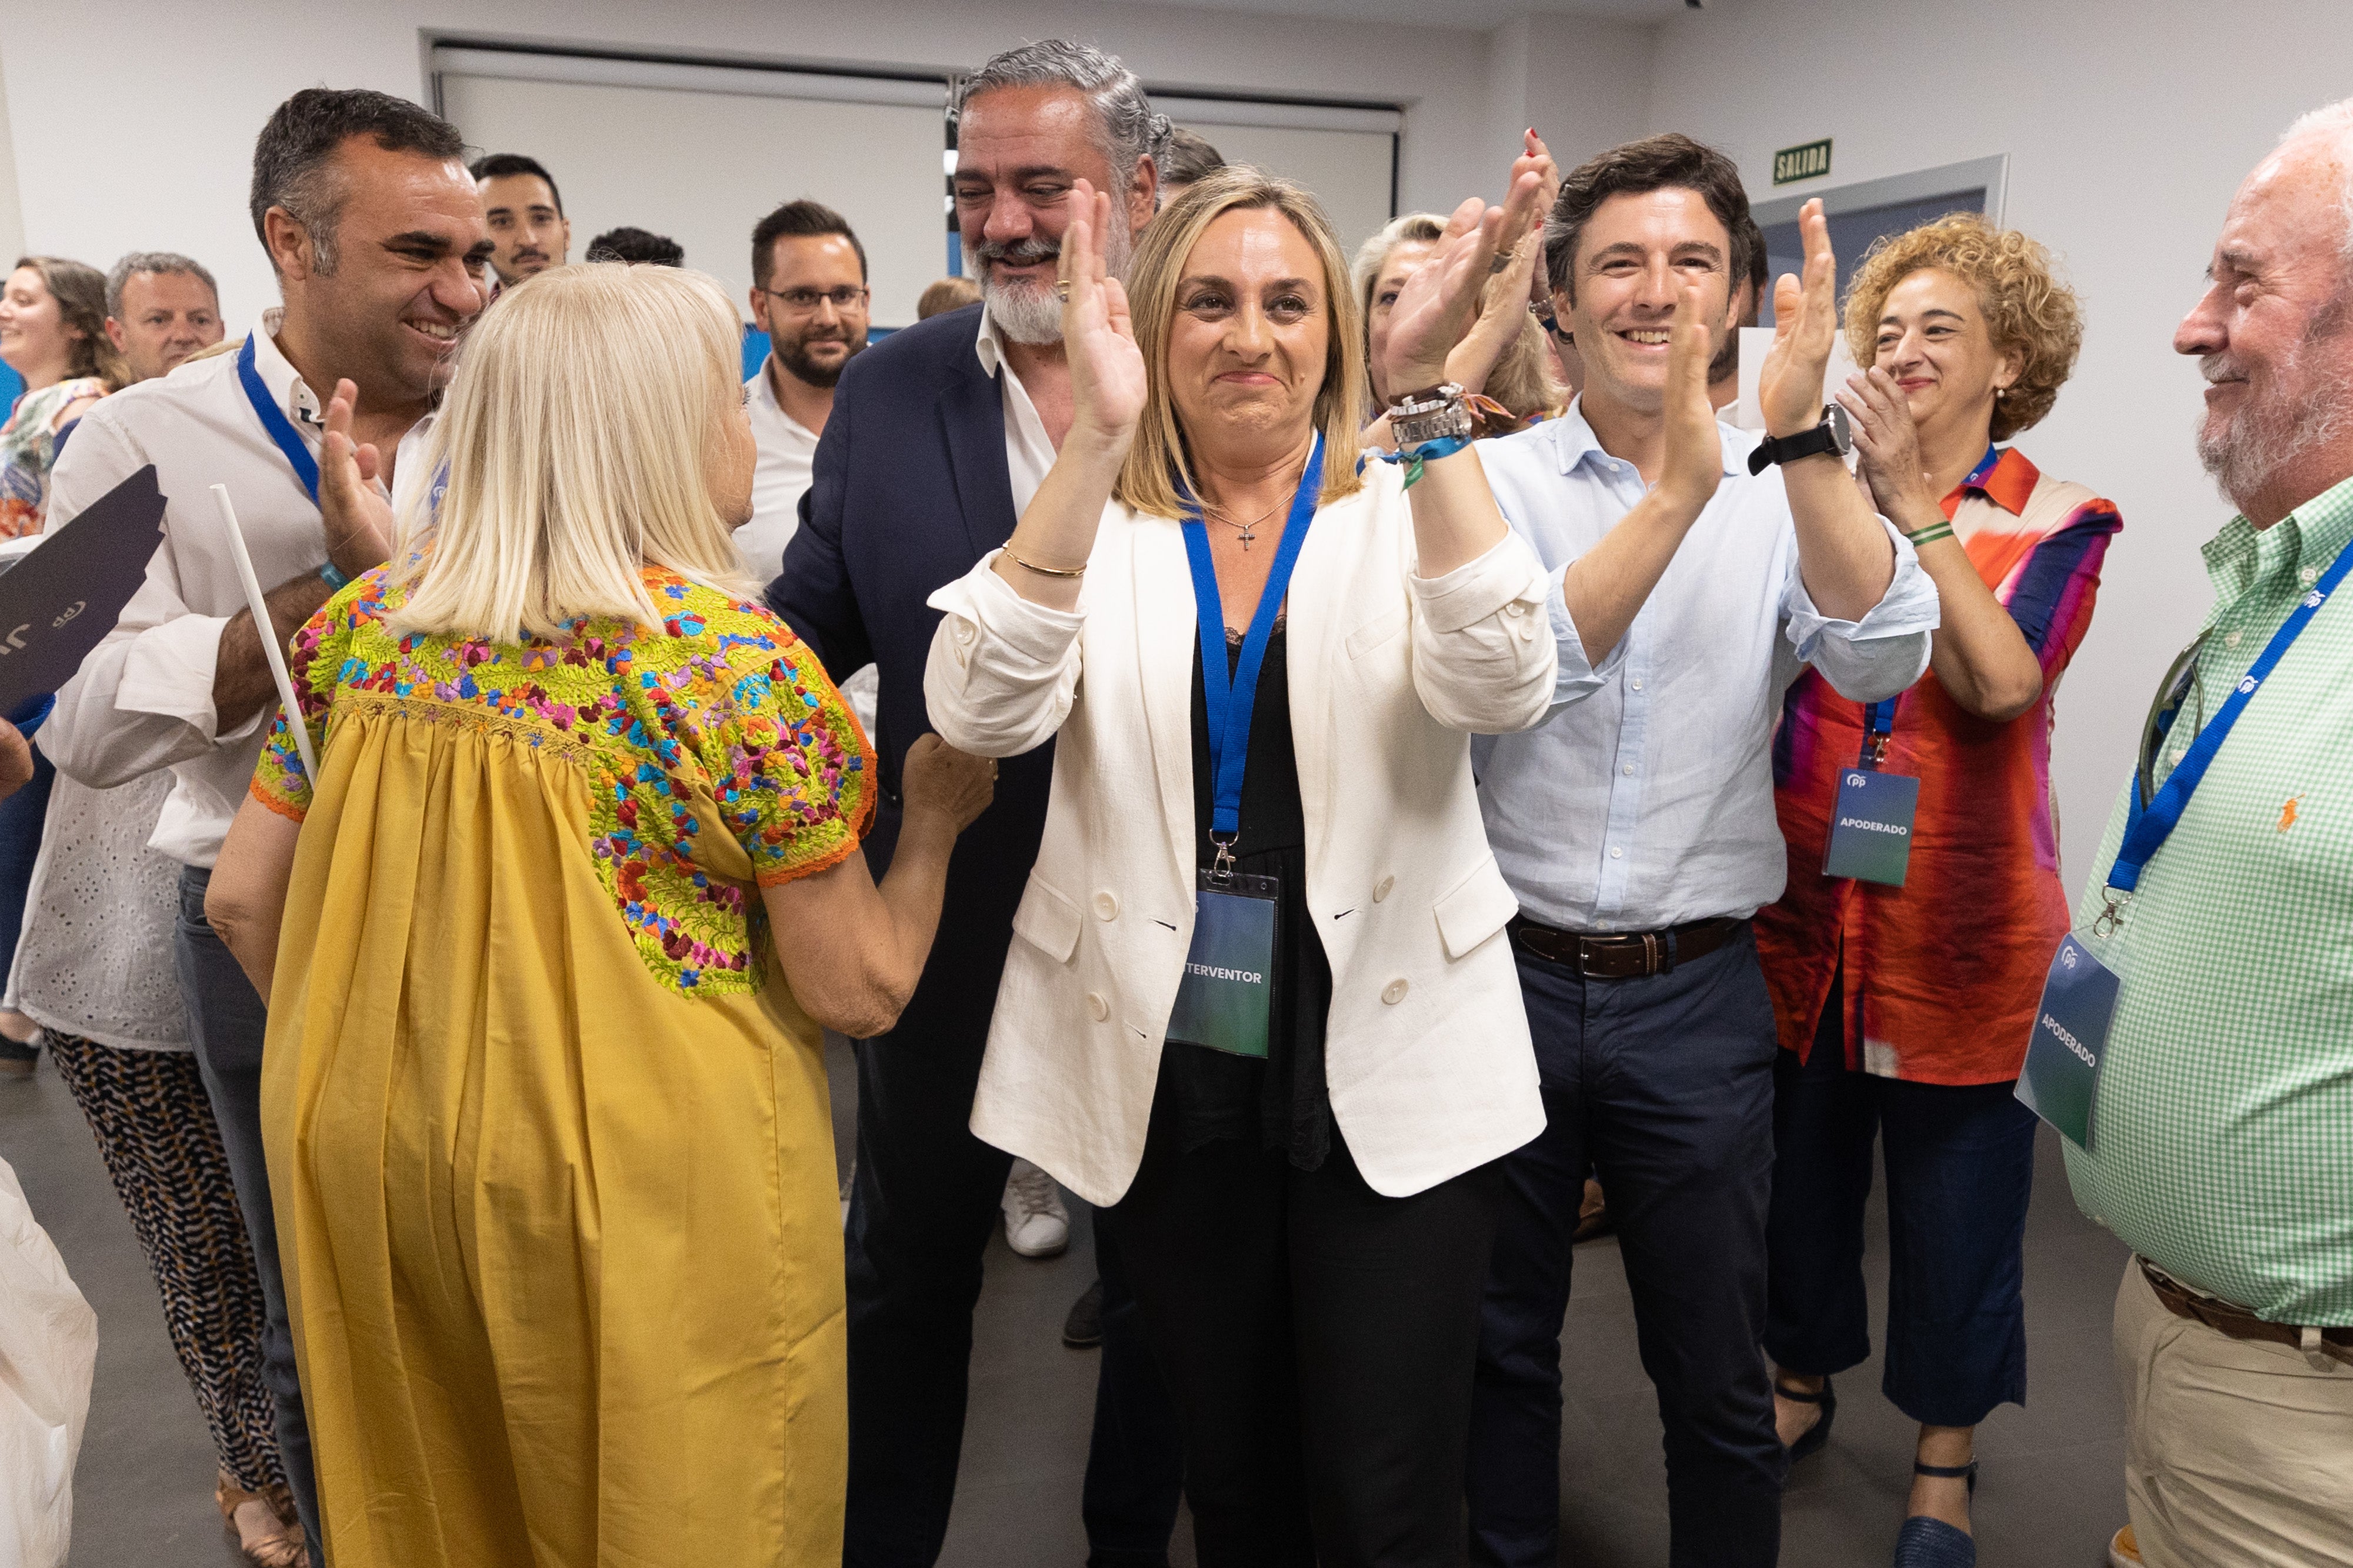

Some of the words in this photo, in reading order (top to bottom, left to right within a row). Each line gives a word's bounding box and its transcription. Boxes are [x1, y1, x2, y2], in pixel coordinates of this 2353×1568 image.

[1778, 145, 1827, 179] SALIDA
[1840, 818, 1907, 835] APODERADO
[1184, 962, 1262, 984] TERVENTOR
[2042, 1013, 2096, 1067] APODERADO
